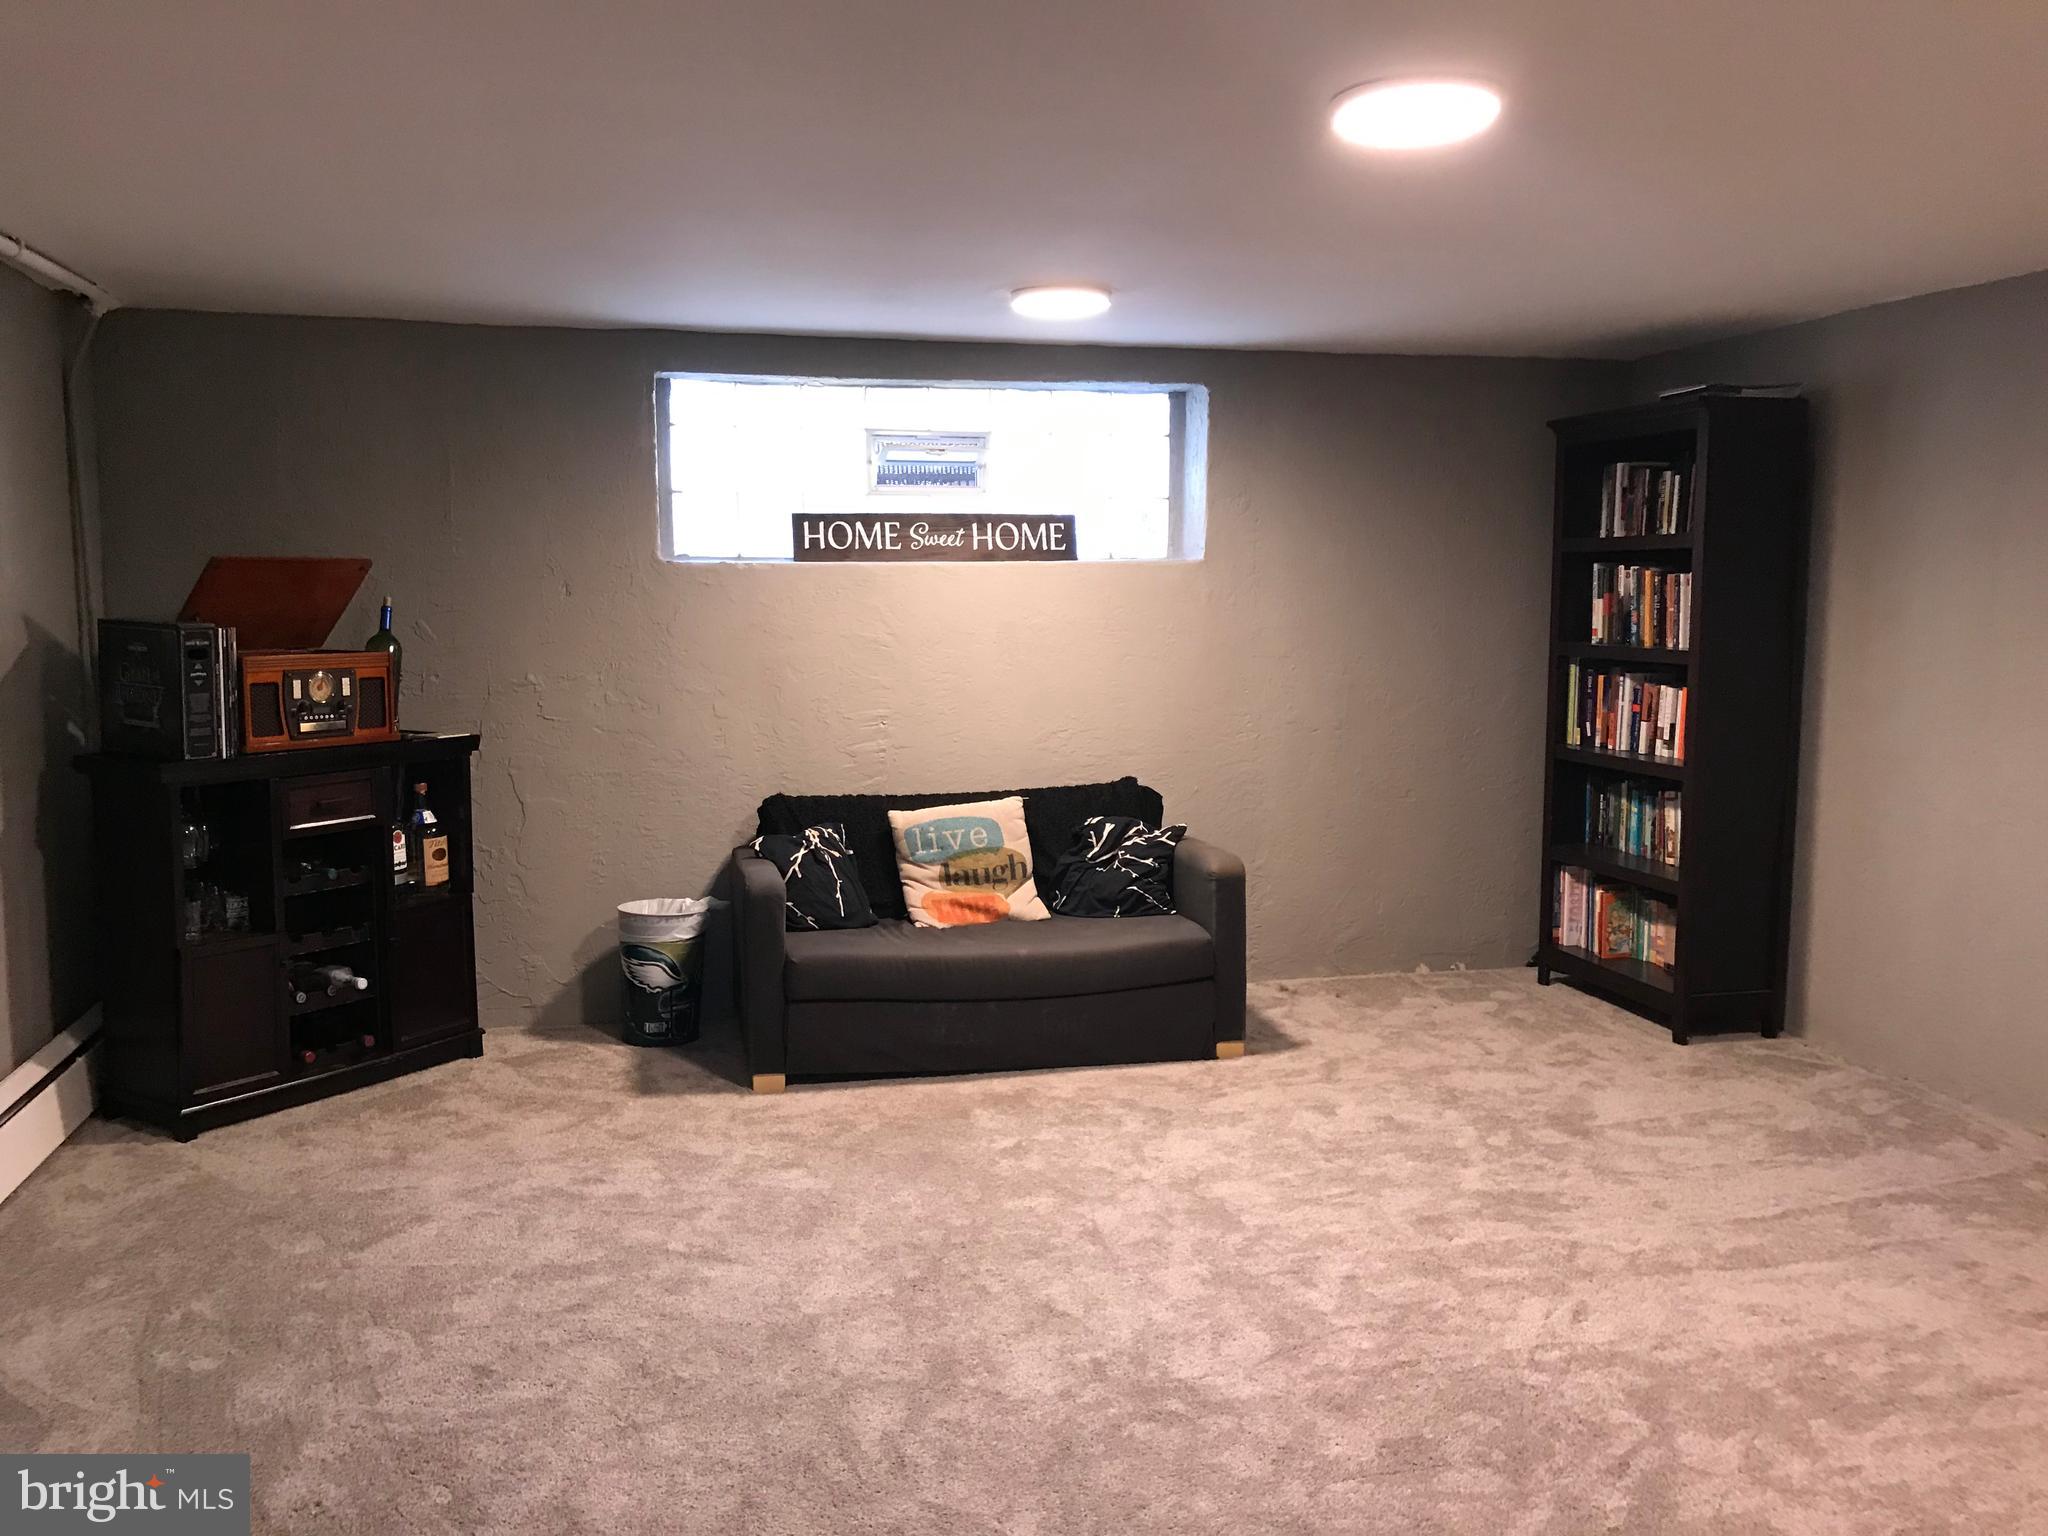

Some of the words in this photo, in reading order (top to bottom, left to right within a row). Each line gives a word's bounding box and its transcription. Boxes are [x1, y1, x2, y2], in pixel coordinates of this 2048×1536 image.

[803, 521, 901, 550] HOME
[909, 521, 966, 551] Sweet
[971, 522, 1067, 551] HOME
[912, 826, 989, 855] live
[942, 852, 1028, 891] laugh
